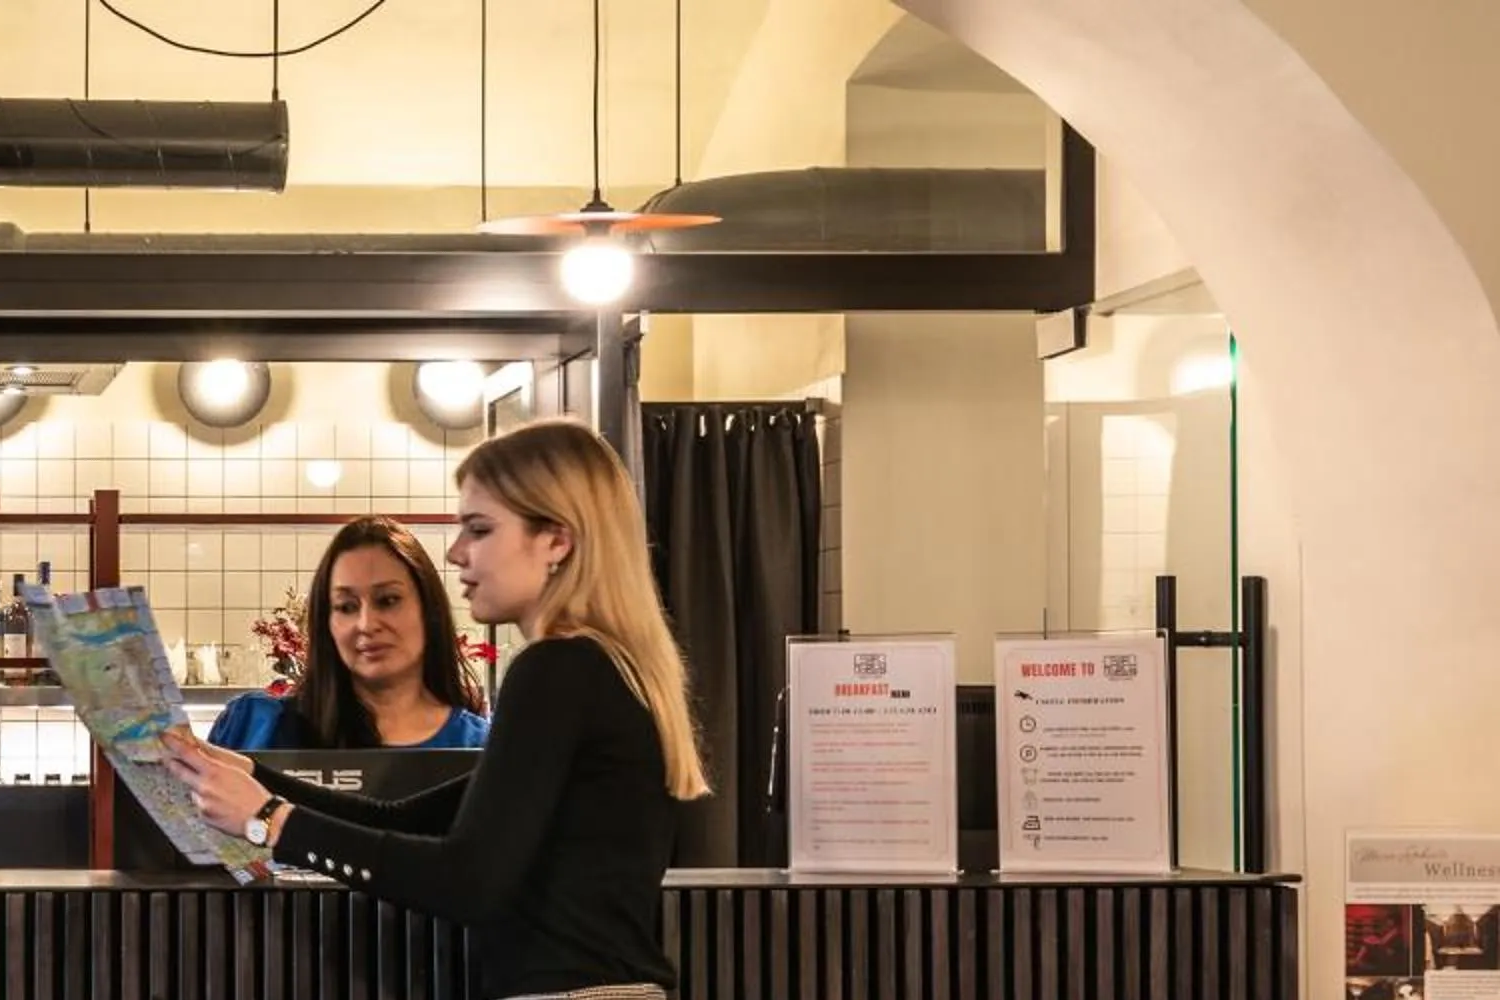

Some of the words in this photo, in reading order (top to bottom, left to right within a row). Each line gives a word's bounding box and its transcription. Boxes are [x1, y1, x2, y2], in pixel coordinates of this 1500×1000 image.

[1021, 662, 1077, 677] WELCOME
[1081, 662, 1095, 676] TO
[835, 683, 890, 697] BREAKFAST
[283, 769, 363, 791] SUS
